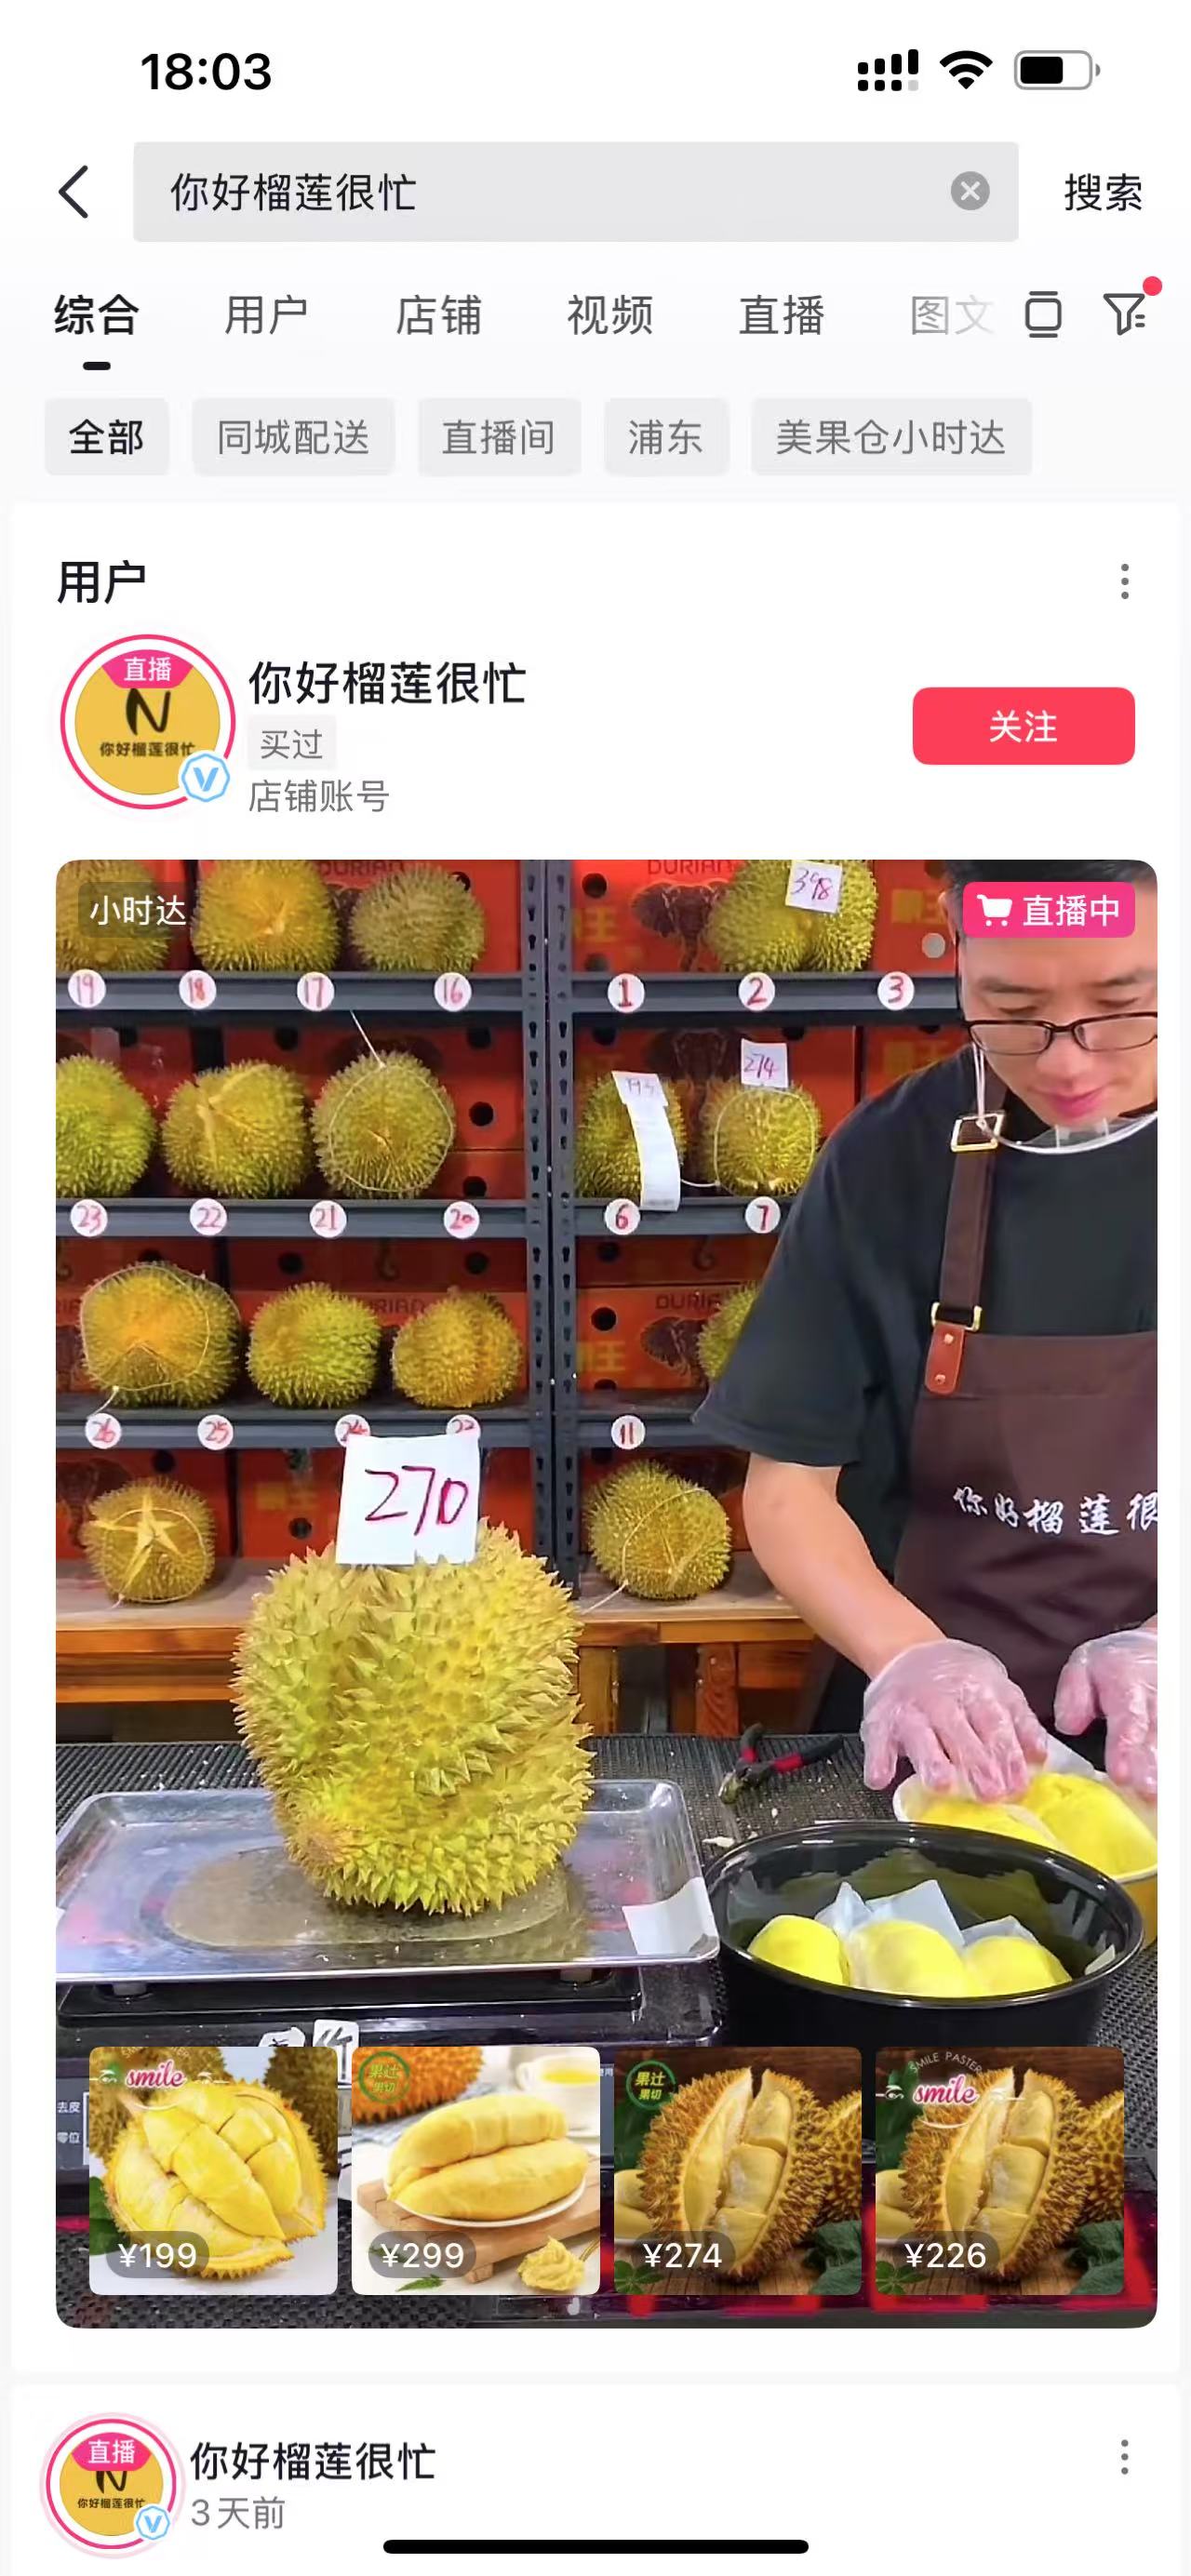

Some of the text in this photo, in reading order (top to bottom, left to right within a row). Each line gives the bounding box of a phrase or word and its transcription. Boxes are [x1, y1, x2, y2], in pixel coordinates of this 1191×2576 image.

[141, 52, 272, 91] 18:03
[170, 172, 417, 212] 你好榴莲很忙
[1064, 172, 1143, 212] 搜索
[53, 293, 141, 336] 综合
[224, 294, 307, 336] 用户
[396, 293, 482, 336] 店铺
[567, 294, 653, 336] 视频
[739, 294, 825, 336] 直播
[911, 294, 995, 336] 图文
[68, 418, 144, 456] 全部
[218, 419, 370, 456] 同城配送
[442, 419, 555, 456] 直播间
[629, 419, 703, 456] 浦东
[776, 419, 1006, 456] 美果仓小时达
[57, 559, 147, 605] 用户
[123, 656, 172, 682] 直播
[248, 661, 527, 705] 你好榴莲很忙
[989, 709, 1058, 743] 关注
[100, 741, 195, 758] 你好榴莲很忙
[261, 728, 323, 760] 买过
[248, 779, 390, 813] 店铺账号
[76, 977, 96, 1004] 19
[186, 977, 207, 1002] 18
[303, 979, 325, 1008] 17
[442, 978, 463, 1004] 16
[617, 978, 634, 1008] 1
[744, 978, 767, 1007] 2
[886, 975, 903, 1004] 3
[76, 1205, 103, 1235] 23
[194, 1208, 224, 1232] 22
[314, 1207, 340, 1232] 21
[614, 1203, 630, 1230] 6
[755, 1204, 772, 1231] 7
[91, 1421, 117, 1445] 26
[203, 1421, 230, 1446] 25
[618, 1420, 637, 1446] 11
[364, 1463, 470, 1537] 270
[125, 2059, 187, 2089] smile
[913, 2074, 980, 2104] smile
[88, 2439, 136, 2465] 直播
[189, 2441, 436, 2481] 你好榴莲很忙
